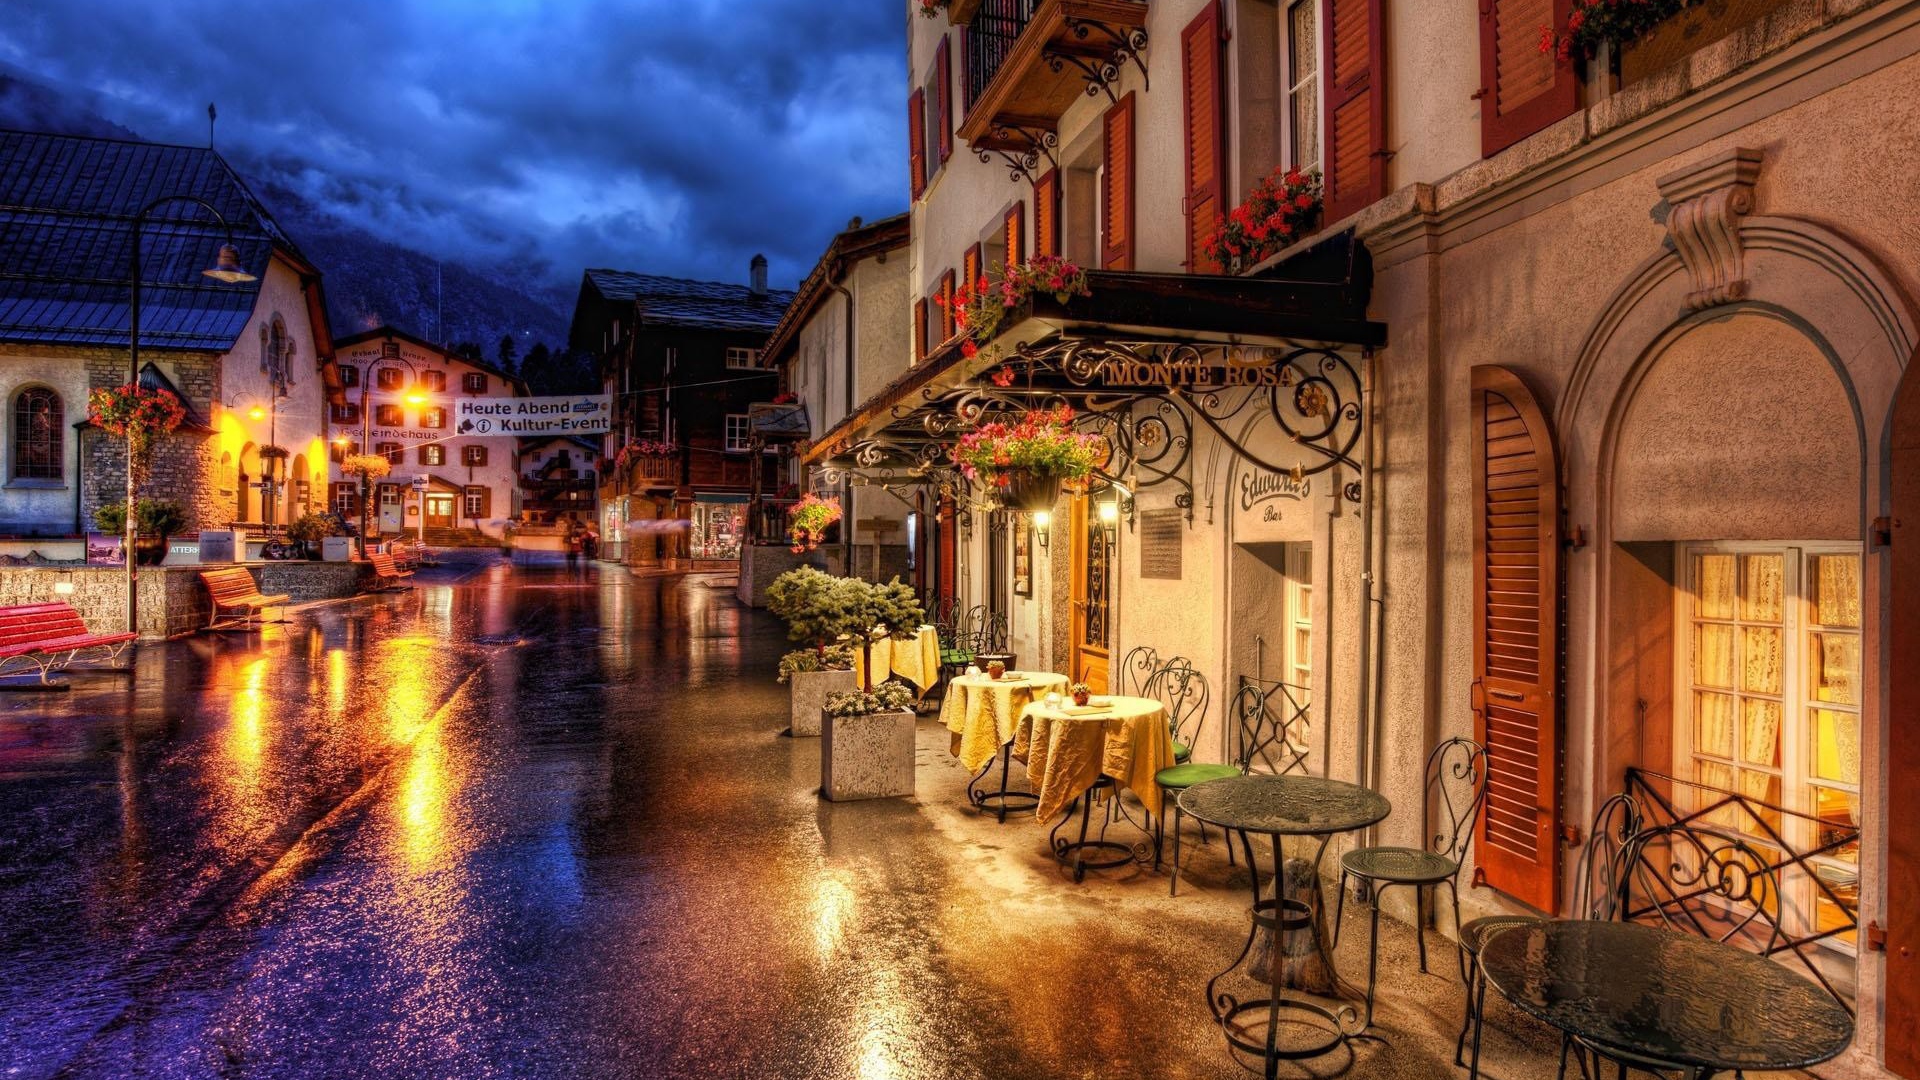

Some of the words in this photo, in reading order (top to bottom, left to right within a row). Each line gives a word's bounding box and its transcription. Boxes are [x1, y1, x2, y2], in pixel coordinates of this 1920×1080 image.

[1107, 363, 1211, 386] MONTE
[1224, 363, 1294, 387] ROSA
[462, 402, 512, 415] Heute
[517, 401, 570, 414] Abend
[501, 416, 609, 431] Kultur-Event
[1241, 467, 1311, 511] Edwars
[1263, 504, 1283, 523] Bar
